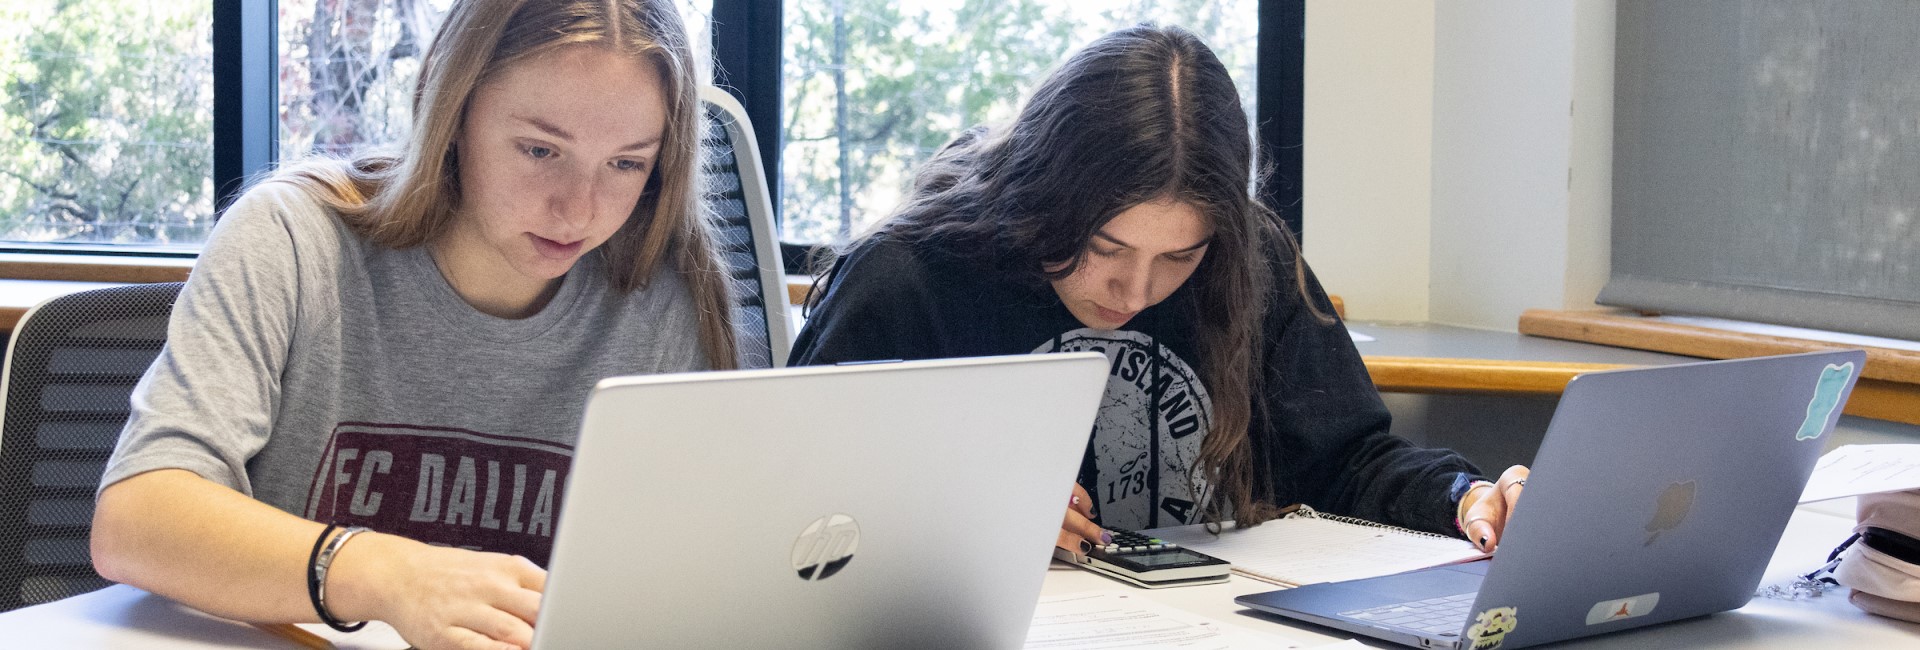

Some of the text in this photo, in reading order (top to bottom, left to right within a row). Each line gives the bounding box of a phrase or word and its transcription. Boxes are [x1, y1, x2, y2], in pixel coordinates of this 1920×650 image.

[1110, 346, 1200, 440] ISLAND
[331, 448, 572, 537] FC DALLA
[1106, 470, 1151, 504] 173
[796, 514, 857, 581] hp
